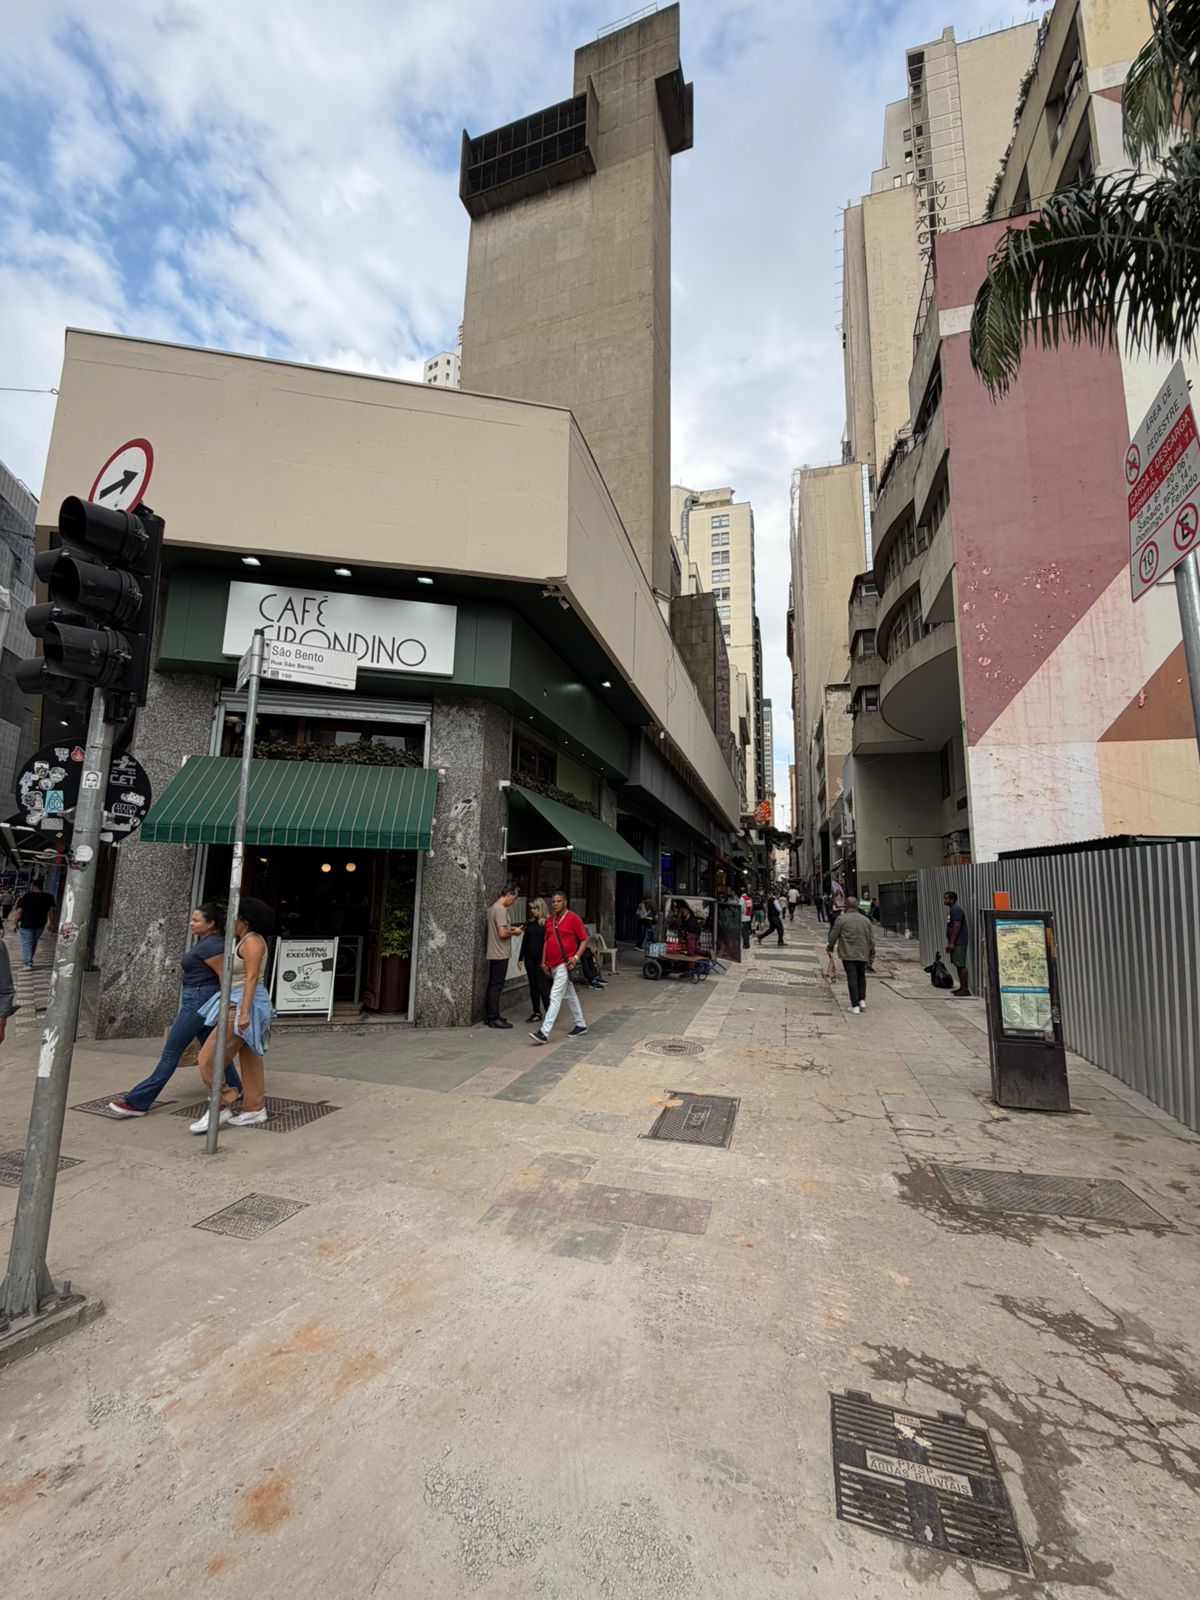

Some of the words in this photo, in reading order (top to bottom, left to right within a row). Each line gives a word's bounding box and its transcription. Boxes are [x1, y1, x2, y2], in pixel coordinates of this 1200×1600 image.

[1145, 404, 1162, 434] ÁREA
[1162, 384, 1173, 405] DE
[1146, 398, 1180, 456] PEDESTRE
[1129, 473, 1150, 504] CARGA
[1149, 464, 1155, 477] E
[1154, 414, 1190, 469] DESCARGA
[1162, 481, 1179, 507] após
[1135, 512, 1164, 546] Domingo
[1164, 505, 1170, 514] e
[1171, 473, 1198, 508] Feriado
[1143, 549, 1154, 571] 10
[259, 593, 329, 627] CAFÉ
[271, 645, 292, 658] São
[294, 648, 324, 663] Bento
[284, 660, 296, 668] São
[297, 663, 315, 671] Bento
[110, 773, 137, 785] CET
[897, 1459, 934, 1474] PMSP
[914, 1472, 970, 1496] PLUVIAIS
